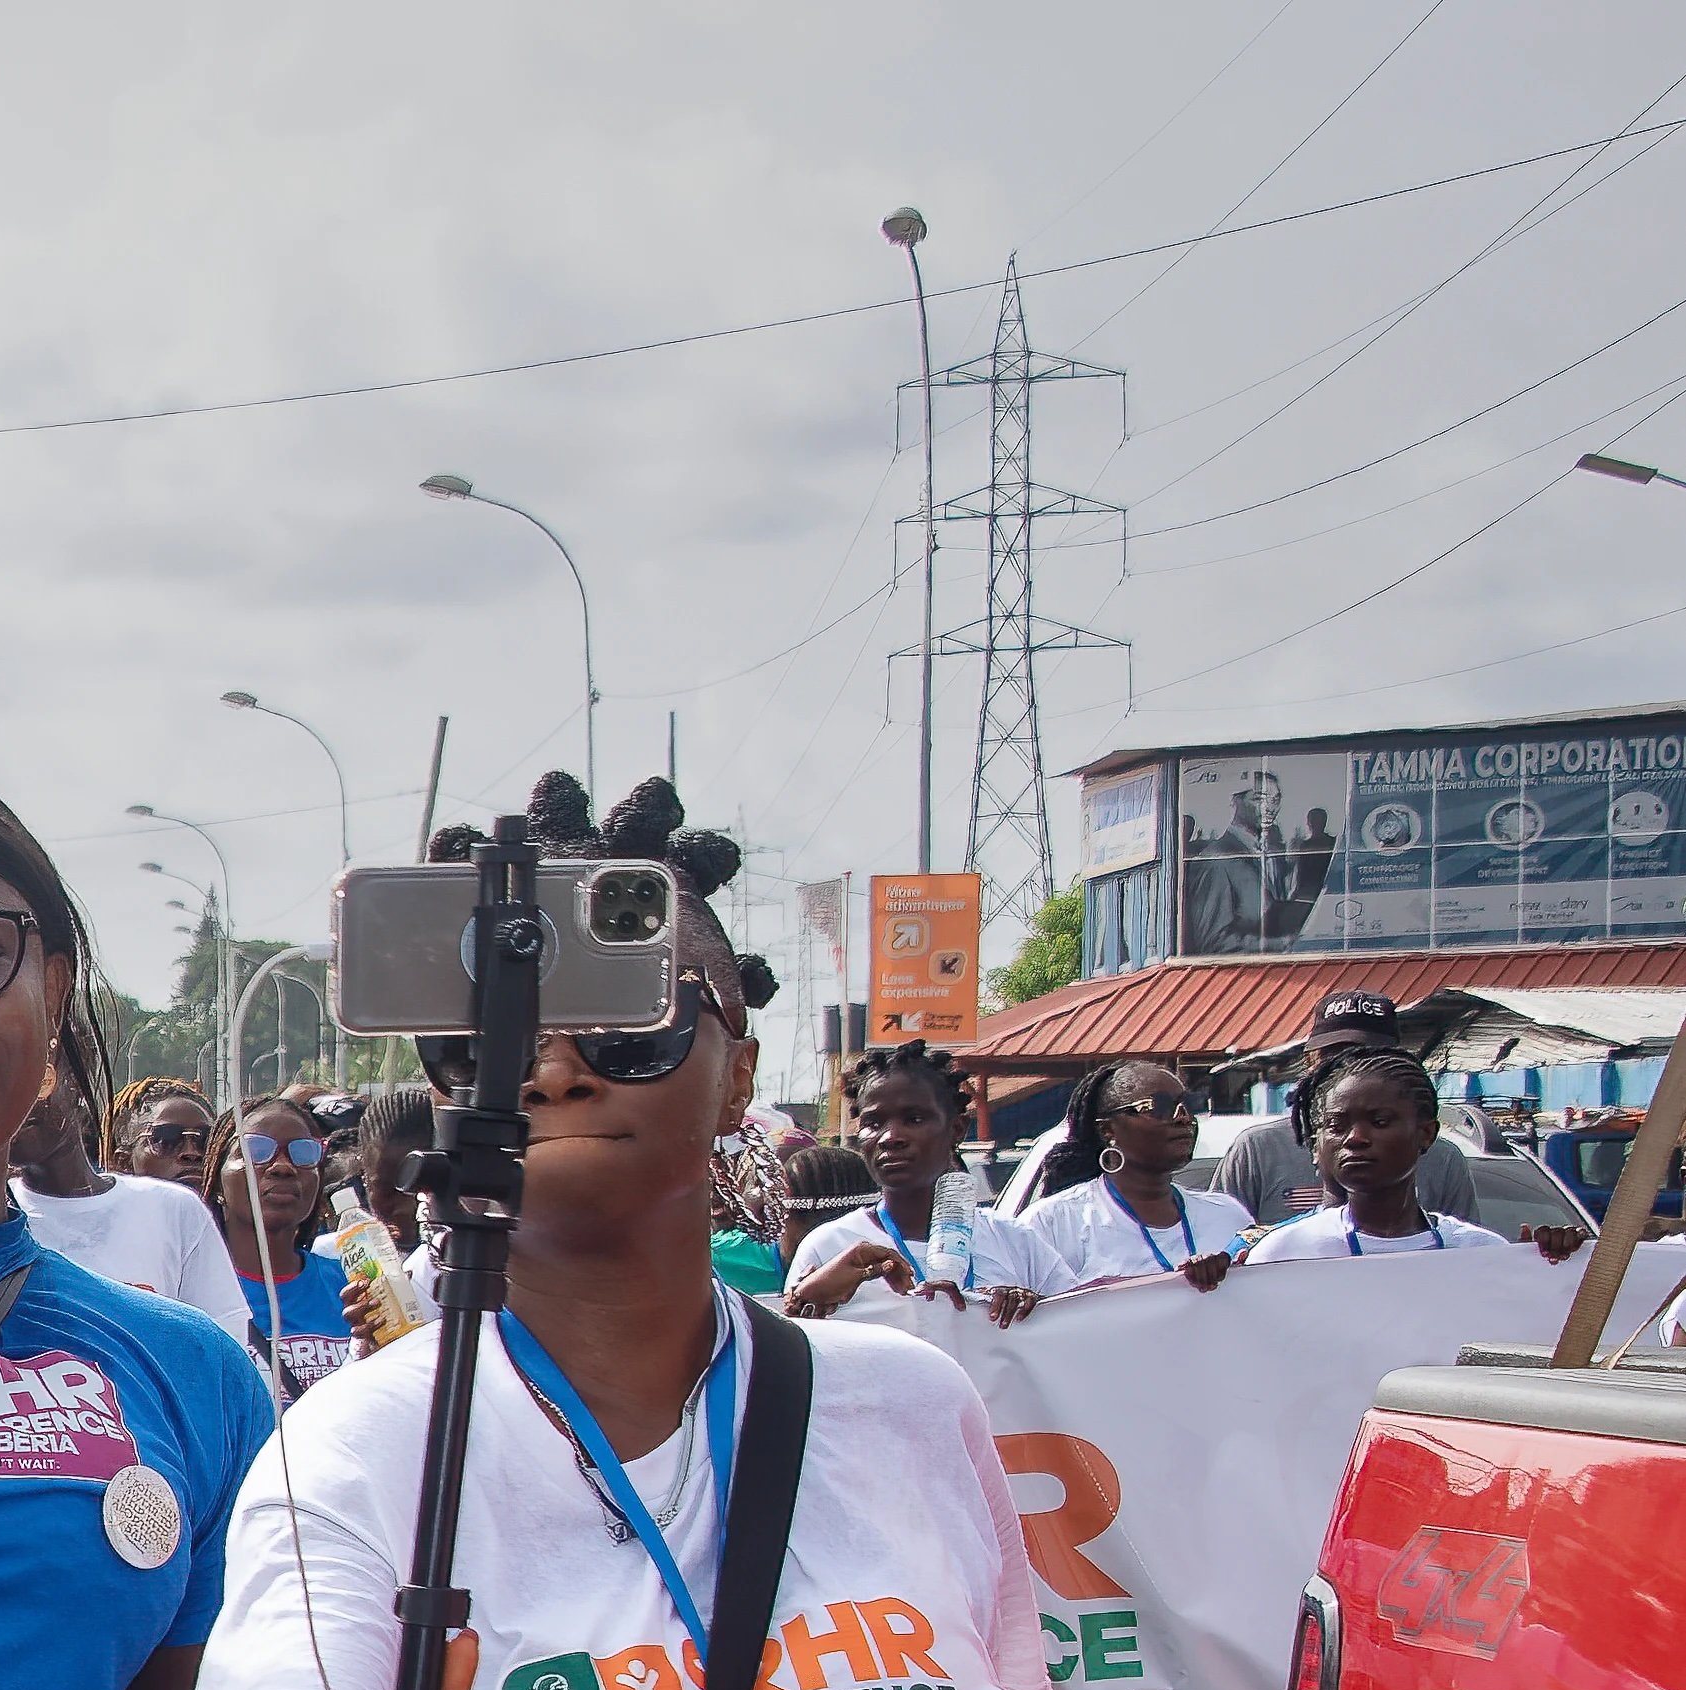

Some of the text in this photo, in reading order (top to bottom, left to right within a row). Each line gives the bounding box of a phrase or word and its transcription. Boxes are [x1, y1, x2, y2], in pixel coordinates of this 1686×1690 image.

[1353, 747, 1467, 783] TAMMA
[1474, 736, 1686, 779] CORPORATIO
[1324, 999, 1385, 1019] POLICE
[17, 1457, 62, 1471] WAIT.
